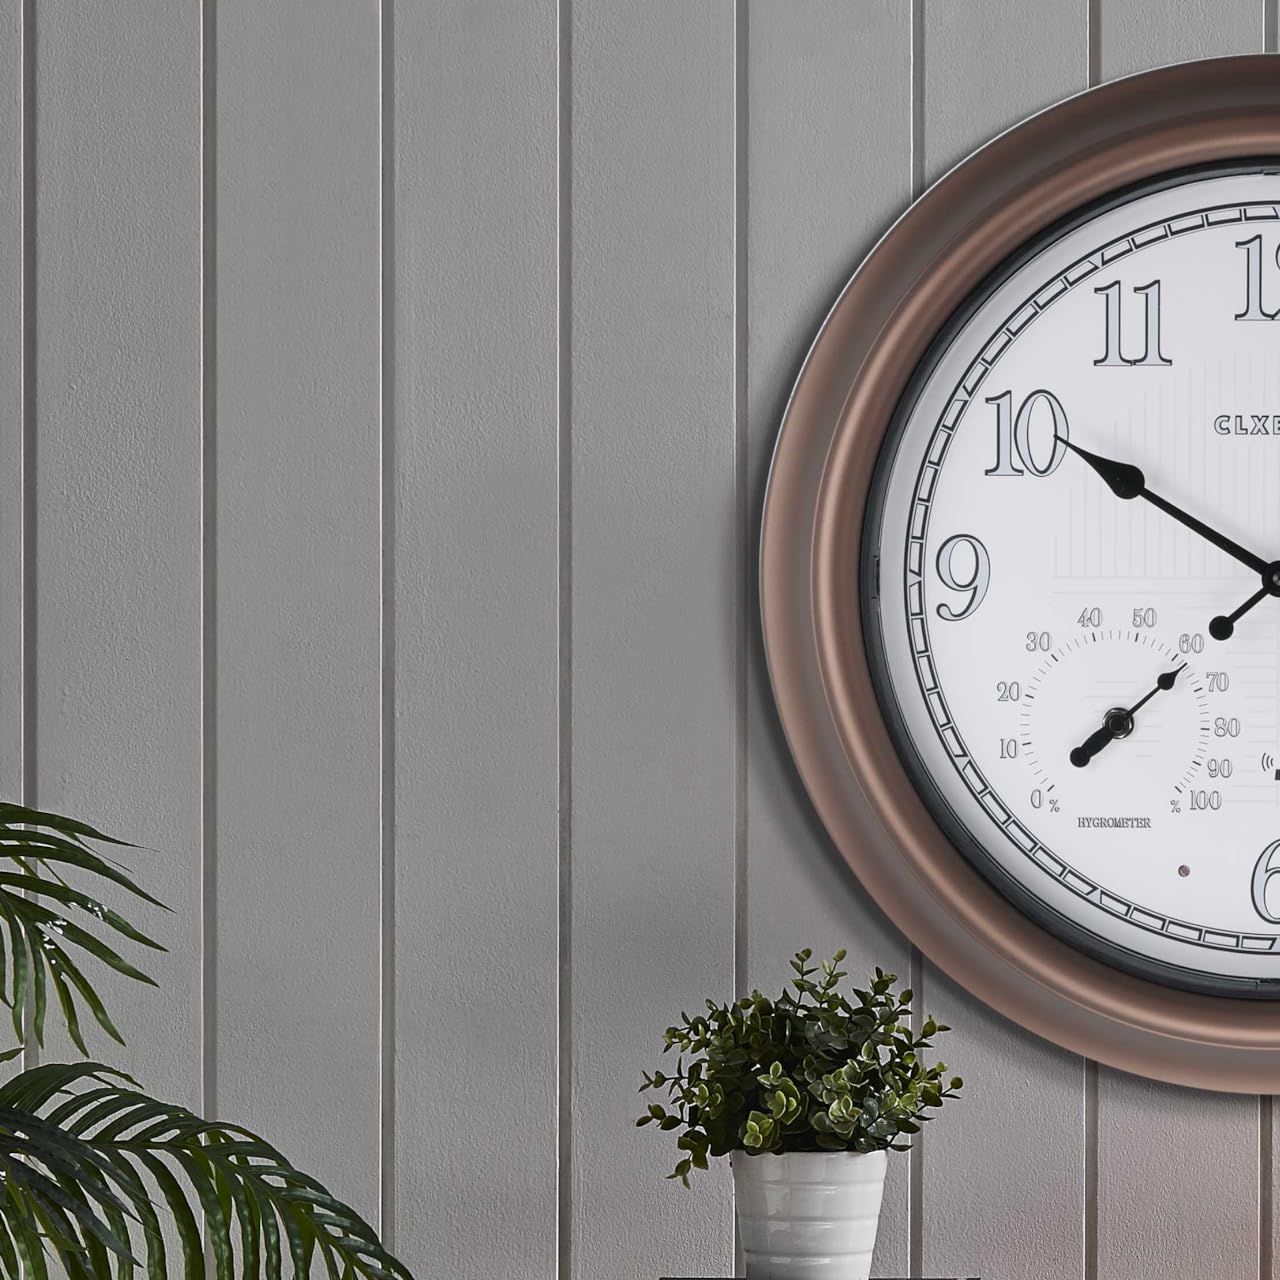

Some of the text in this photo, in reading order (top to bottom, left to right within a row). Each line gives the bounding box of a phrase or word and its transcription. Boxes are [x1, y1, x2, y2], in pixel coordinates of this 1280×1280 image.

[1093, 279, 1173, 367] 11
[984, 389, 1070, 477] 10
[935, 534, 991, 622] 9
[1077, 608, 1103, 628] 40
[1132, 608, 1157, 628] 50
[1025, 632, 1052, 652] 30
[1178, 633, 1205, 654] 60
[996, 681, 1021, 702] 20
[1205, 672, 1229, 692] 70
[1213, 717, 1241, 738] 80
[999, 738, 1018, 759] 10
[1207, 758, 1233, 778] 90
[1030, 789, 1043, 809] 0
[1189, 789, 1223, 810] 100
[1077, 816, 1152, 829] HYGROMETER
